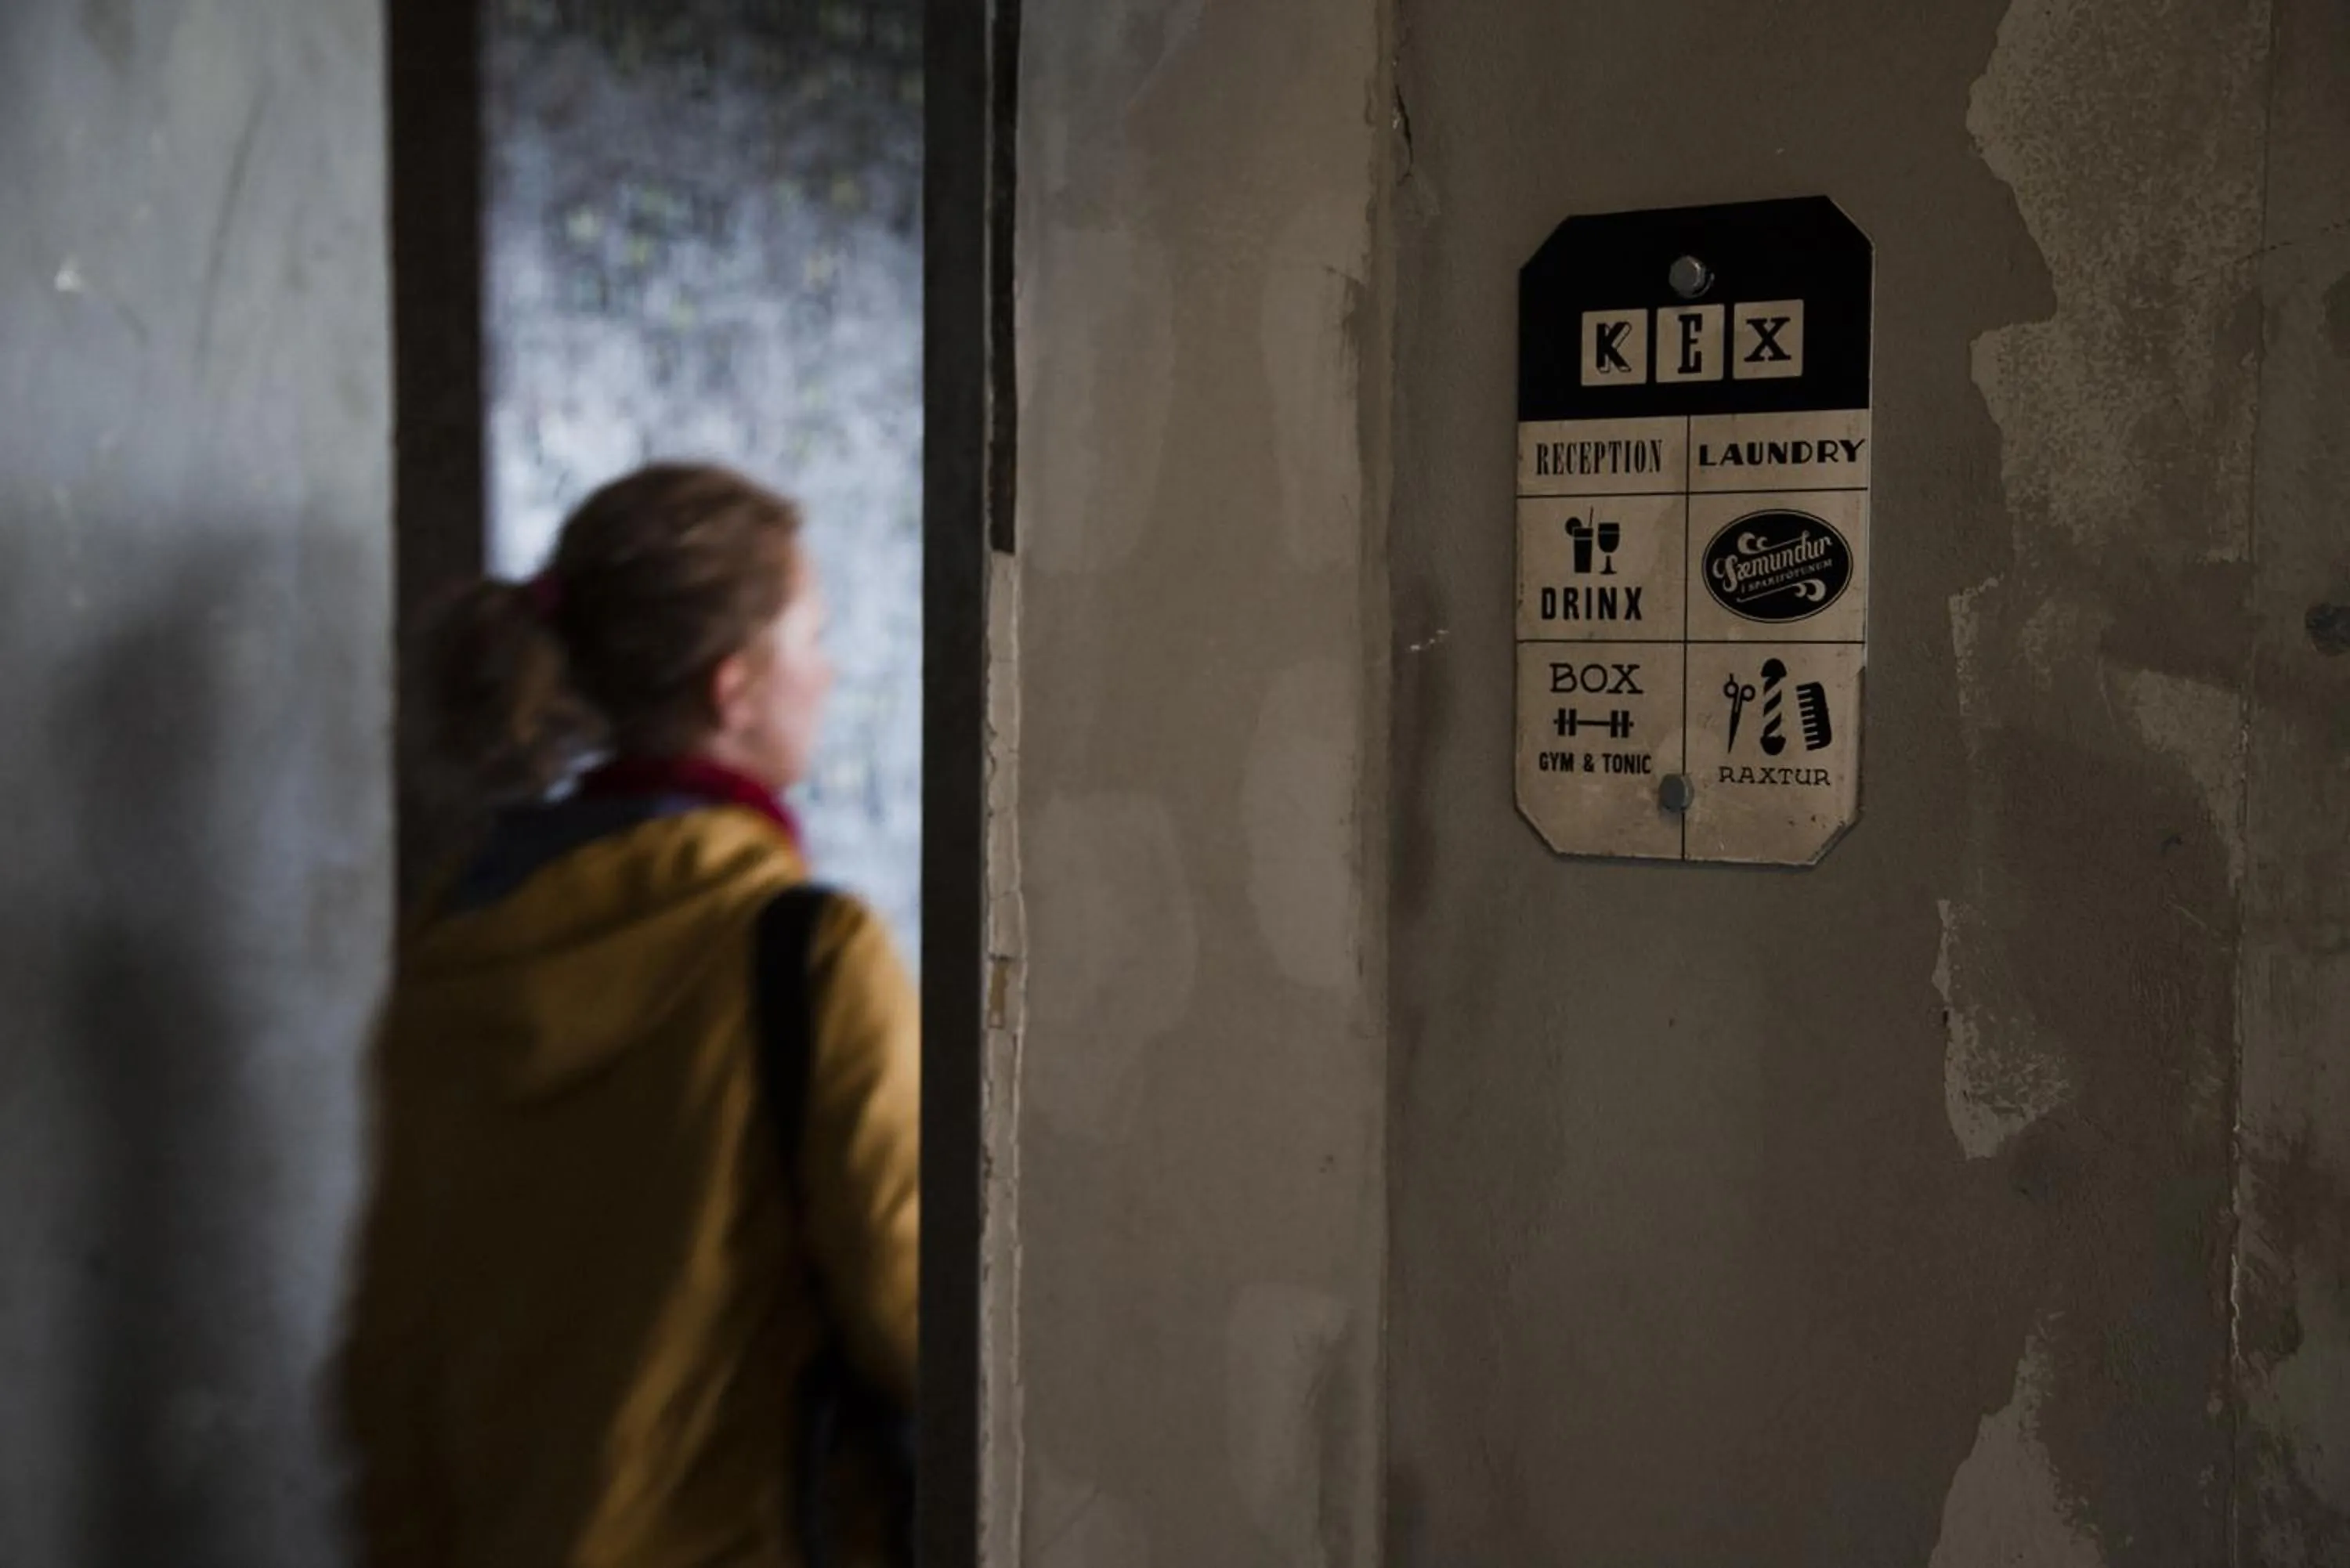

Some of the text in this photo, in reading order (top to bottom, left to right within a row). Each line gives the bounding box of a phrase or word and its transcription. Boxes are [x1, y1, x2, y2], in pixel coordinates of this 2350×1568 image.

[1596, 314, 1791, 374] KEX
[1536, 439, 1663, 475] RECEPTION
[1699, 439, 1866, 466] LAUNDRY
[1540, 587, 1643, 620] DRINX
[1549, 663, 1643, 694] BOX
[1538, 752, 1652, 775] GYM & TONIC
[1719, 766, 1831, 786] RAXTUR
